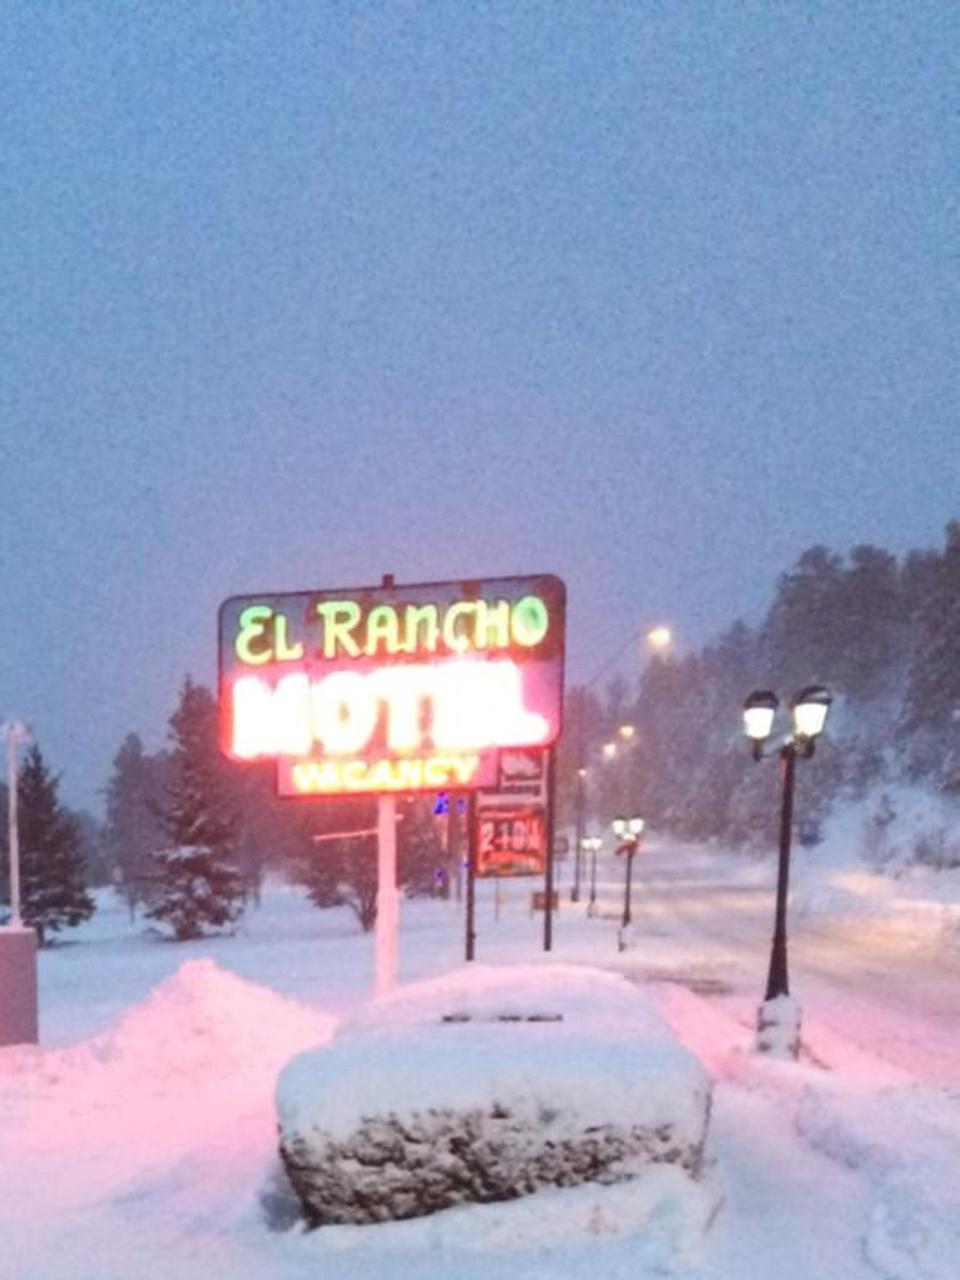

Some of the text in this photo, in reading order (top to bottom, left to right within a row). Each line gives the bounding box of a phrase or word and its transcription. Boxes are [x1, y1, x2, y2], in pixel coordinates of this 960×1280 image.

[235, 595, 549, 664] EL RANCHO
[293, 755, 479, 793] VACANCY
